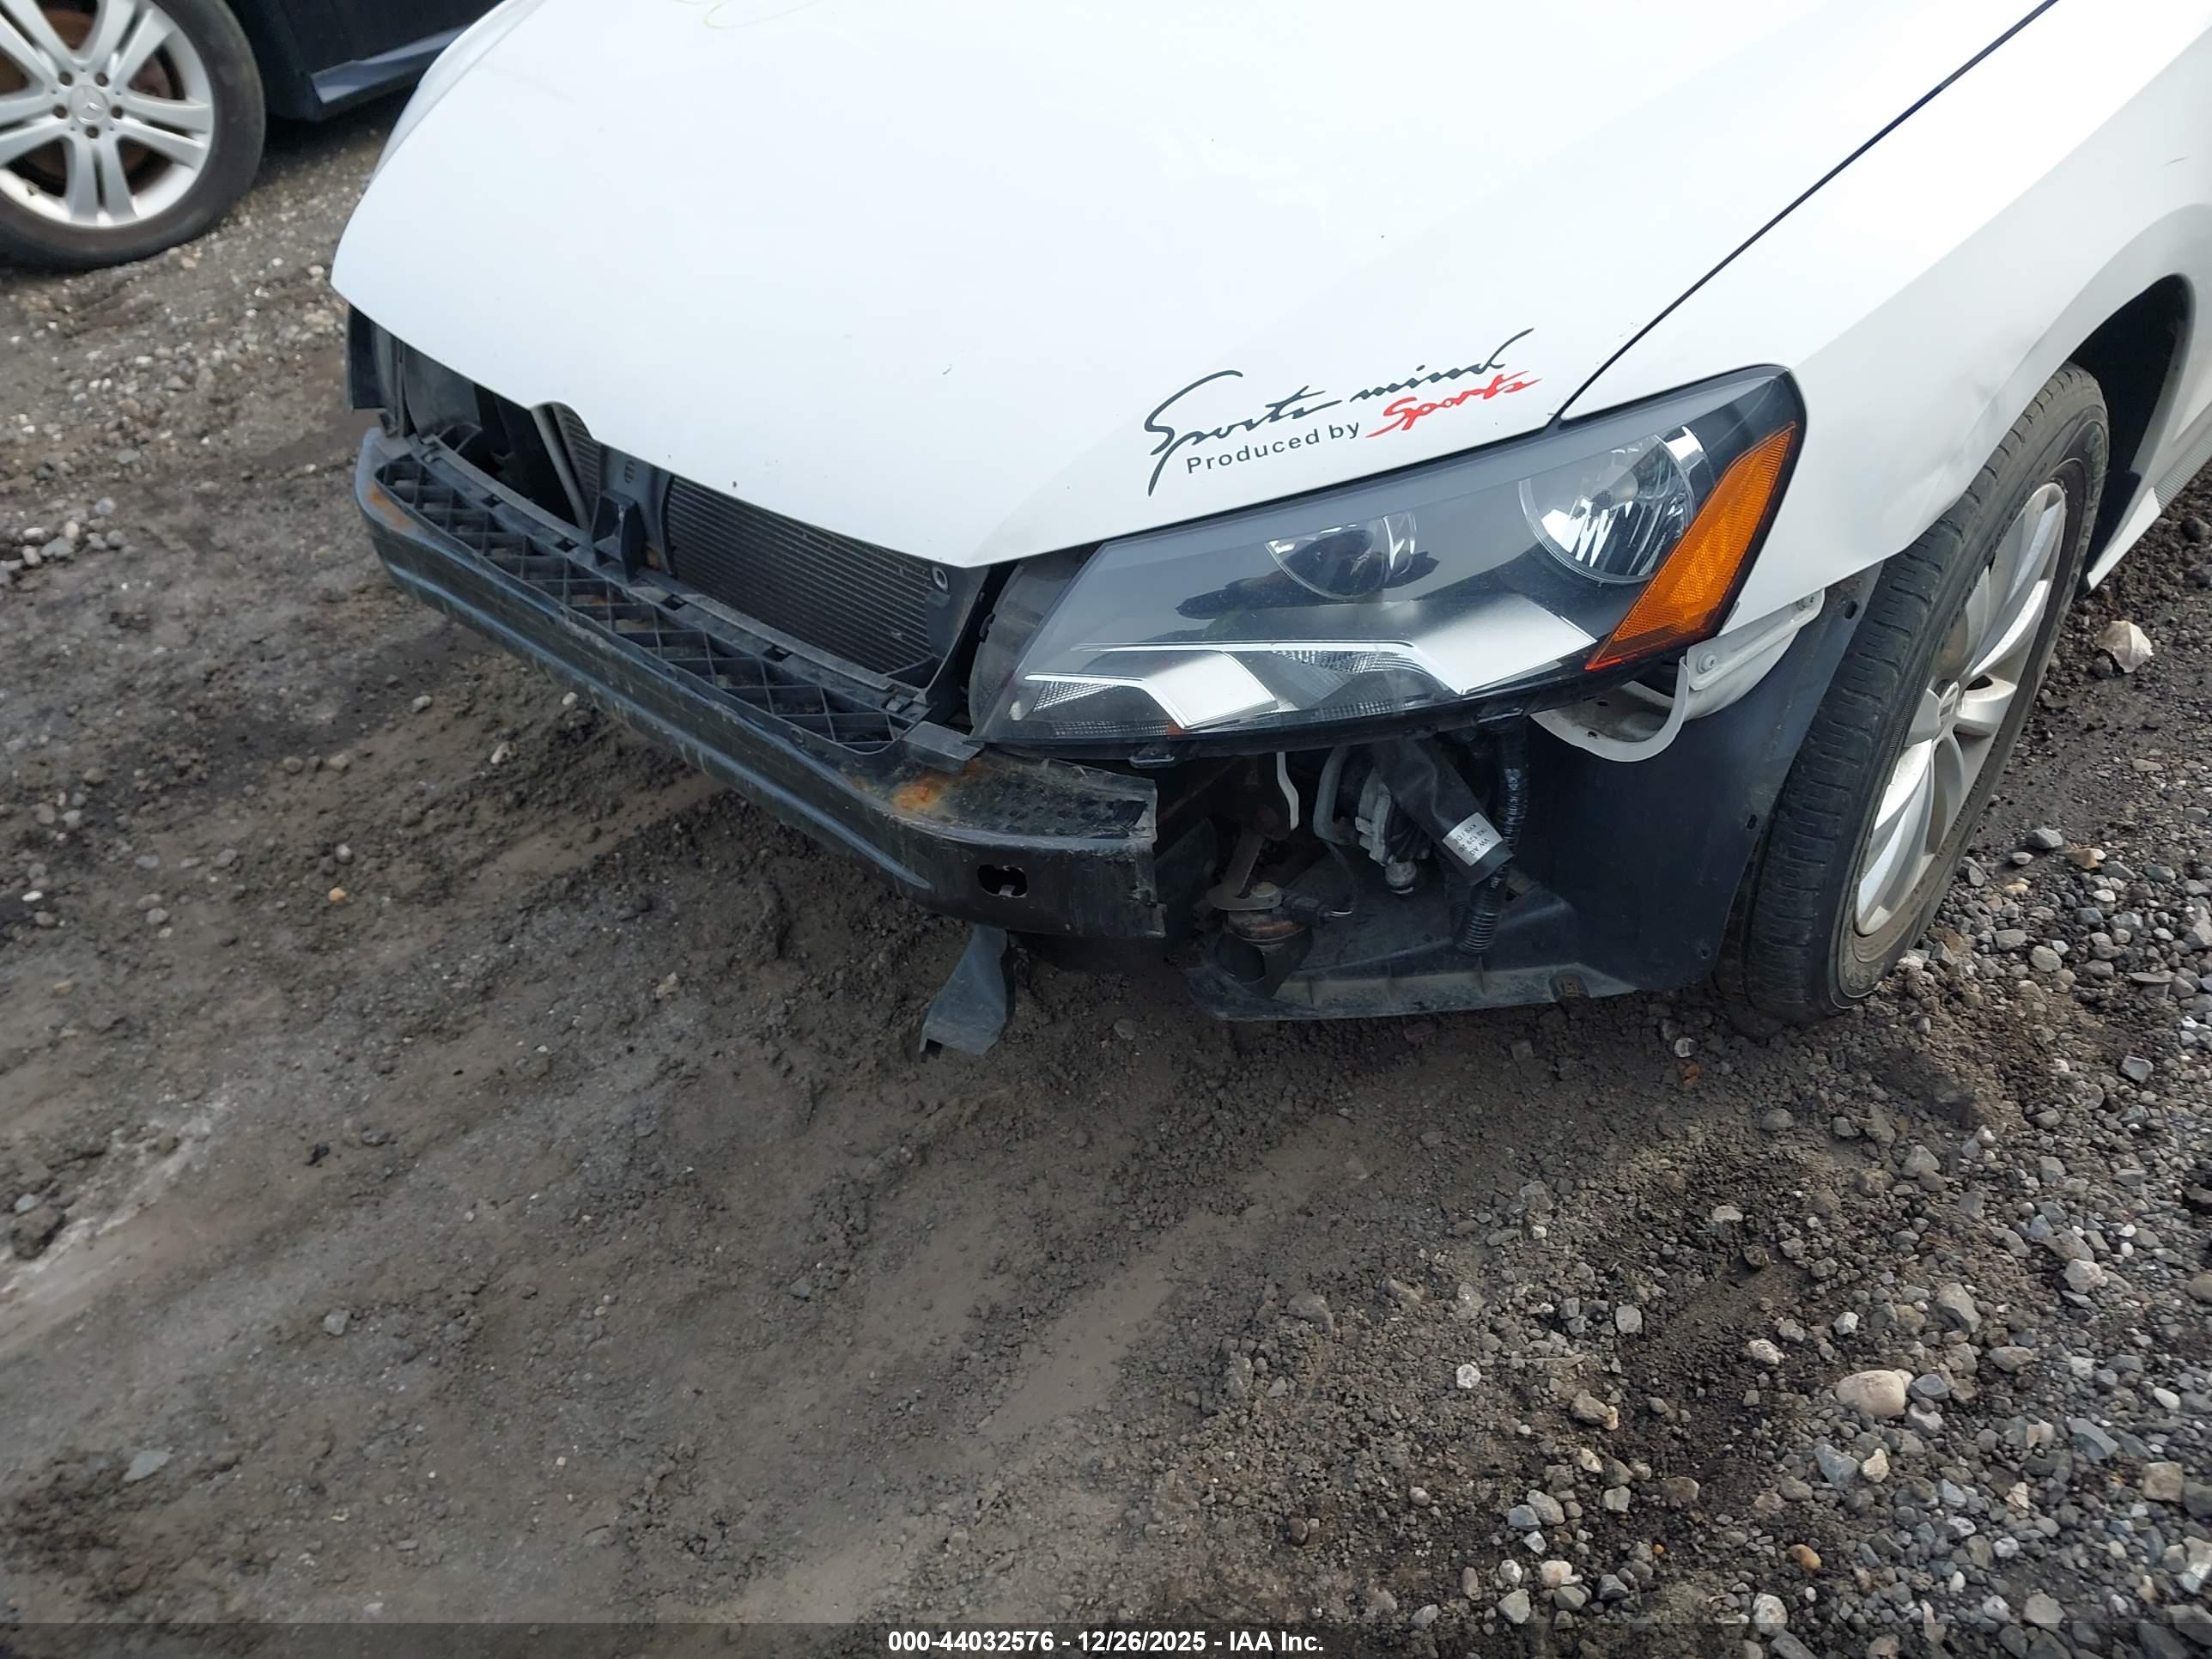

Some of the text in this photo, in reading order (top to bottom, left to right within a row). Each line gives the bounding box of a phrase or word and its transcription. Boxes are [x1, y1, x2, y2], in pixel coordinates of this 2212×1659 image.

[1186, 370, 1543, 474] Produced by Sports
